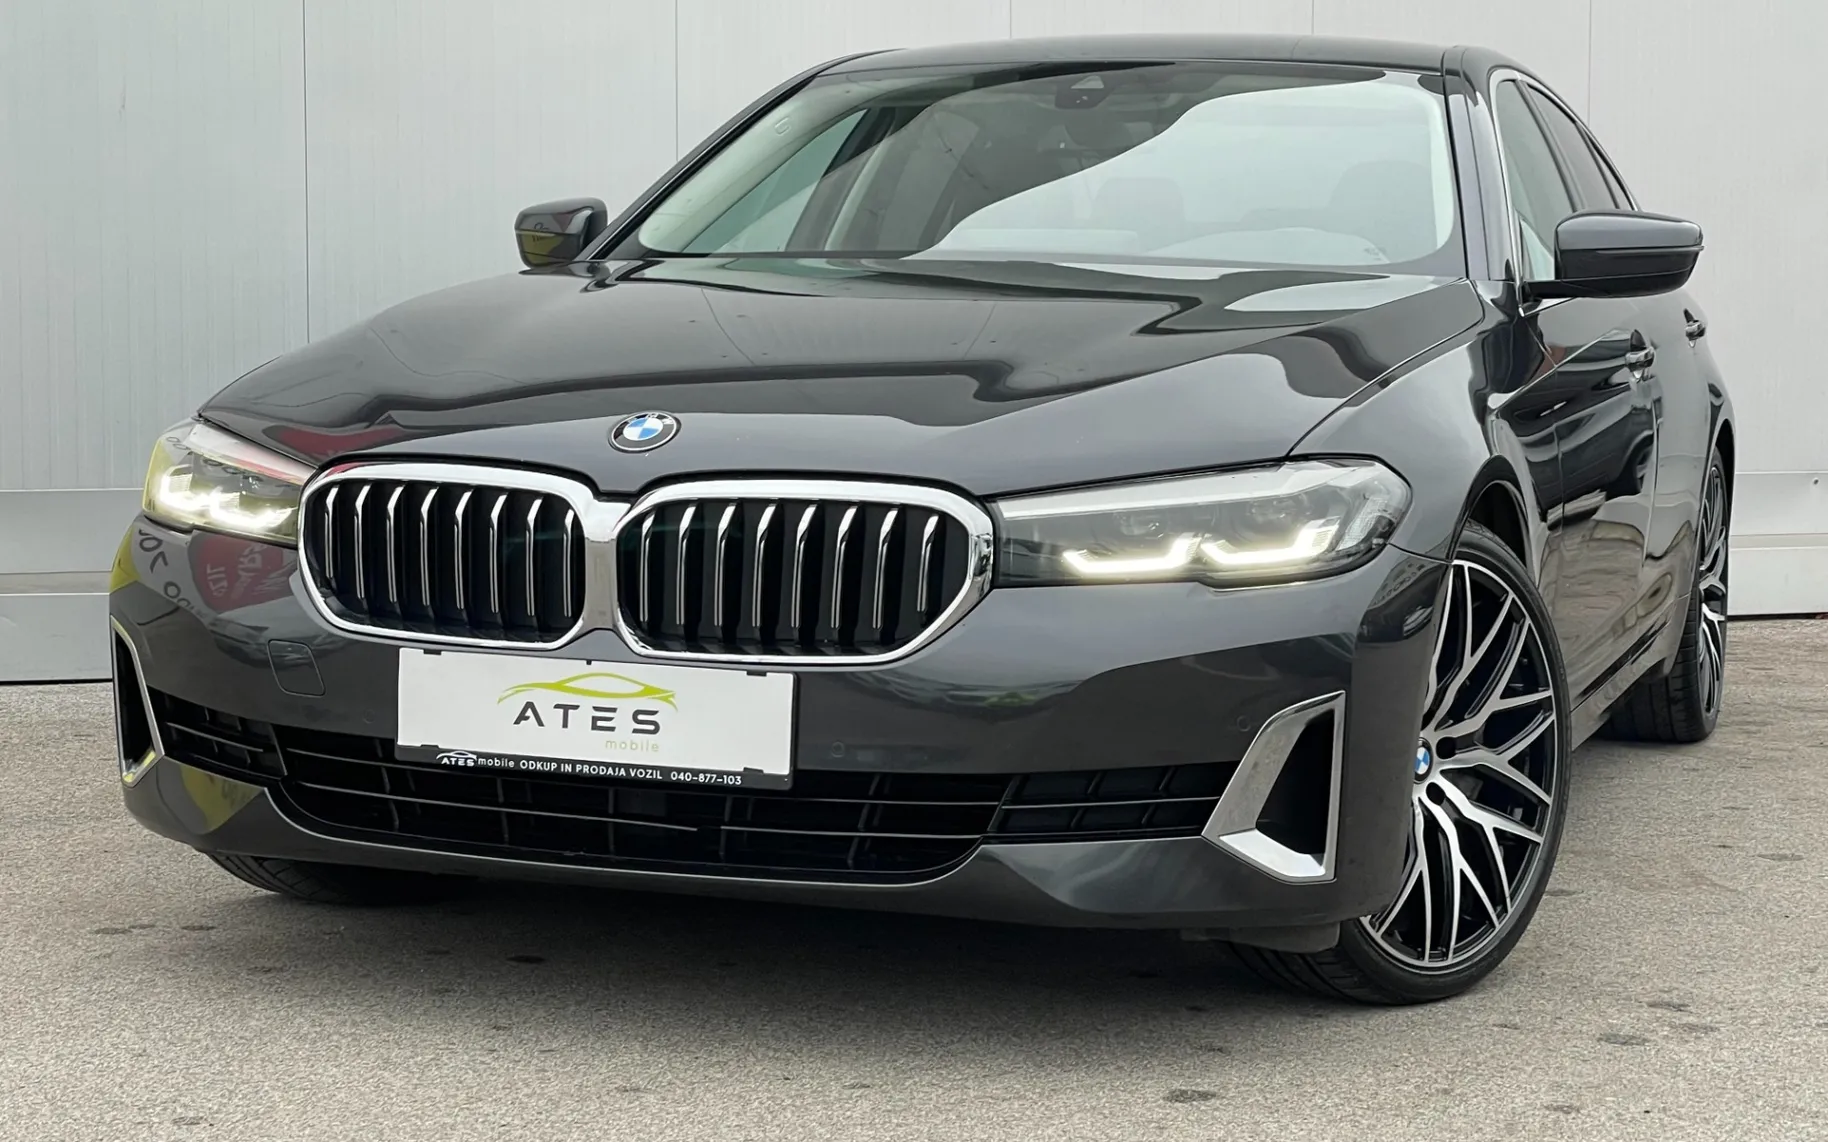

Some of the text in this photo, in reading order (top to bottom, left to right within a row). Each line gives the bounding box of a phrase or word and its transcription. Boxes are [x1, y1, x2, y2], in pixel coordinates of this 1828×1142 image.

[513, 701, 661, 735] ATES
[605, 739, 660, 752] mobile
[441, 757, 742, 785] ATES mobile ODKUP IN PRODAJA VOZIL 040-877-103
